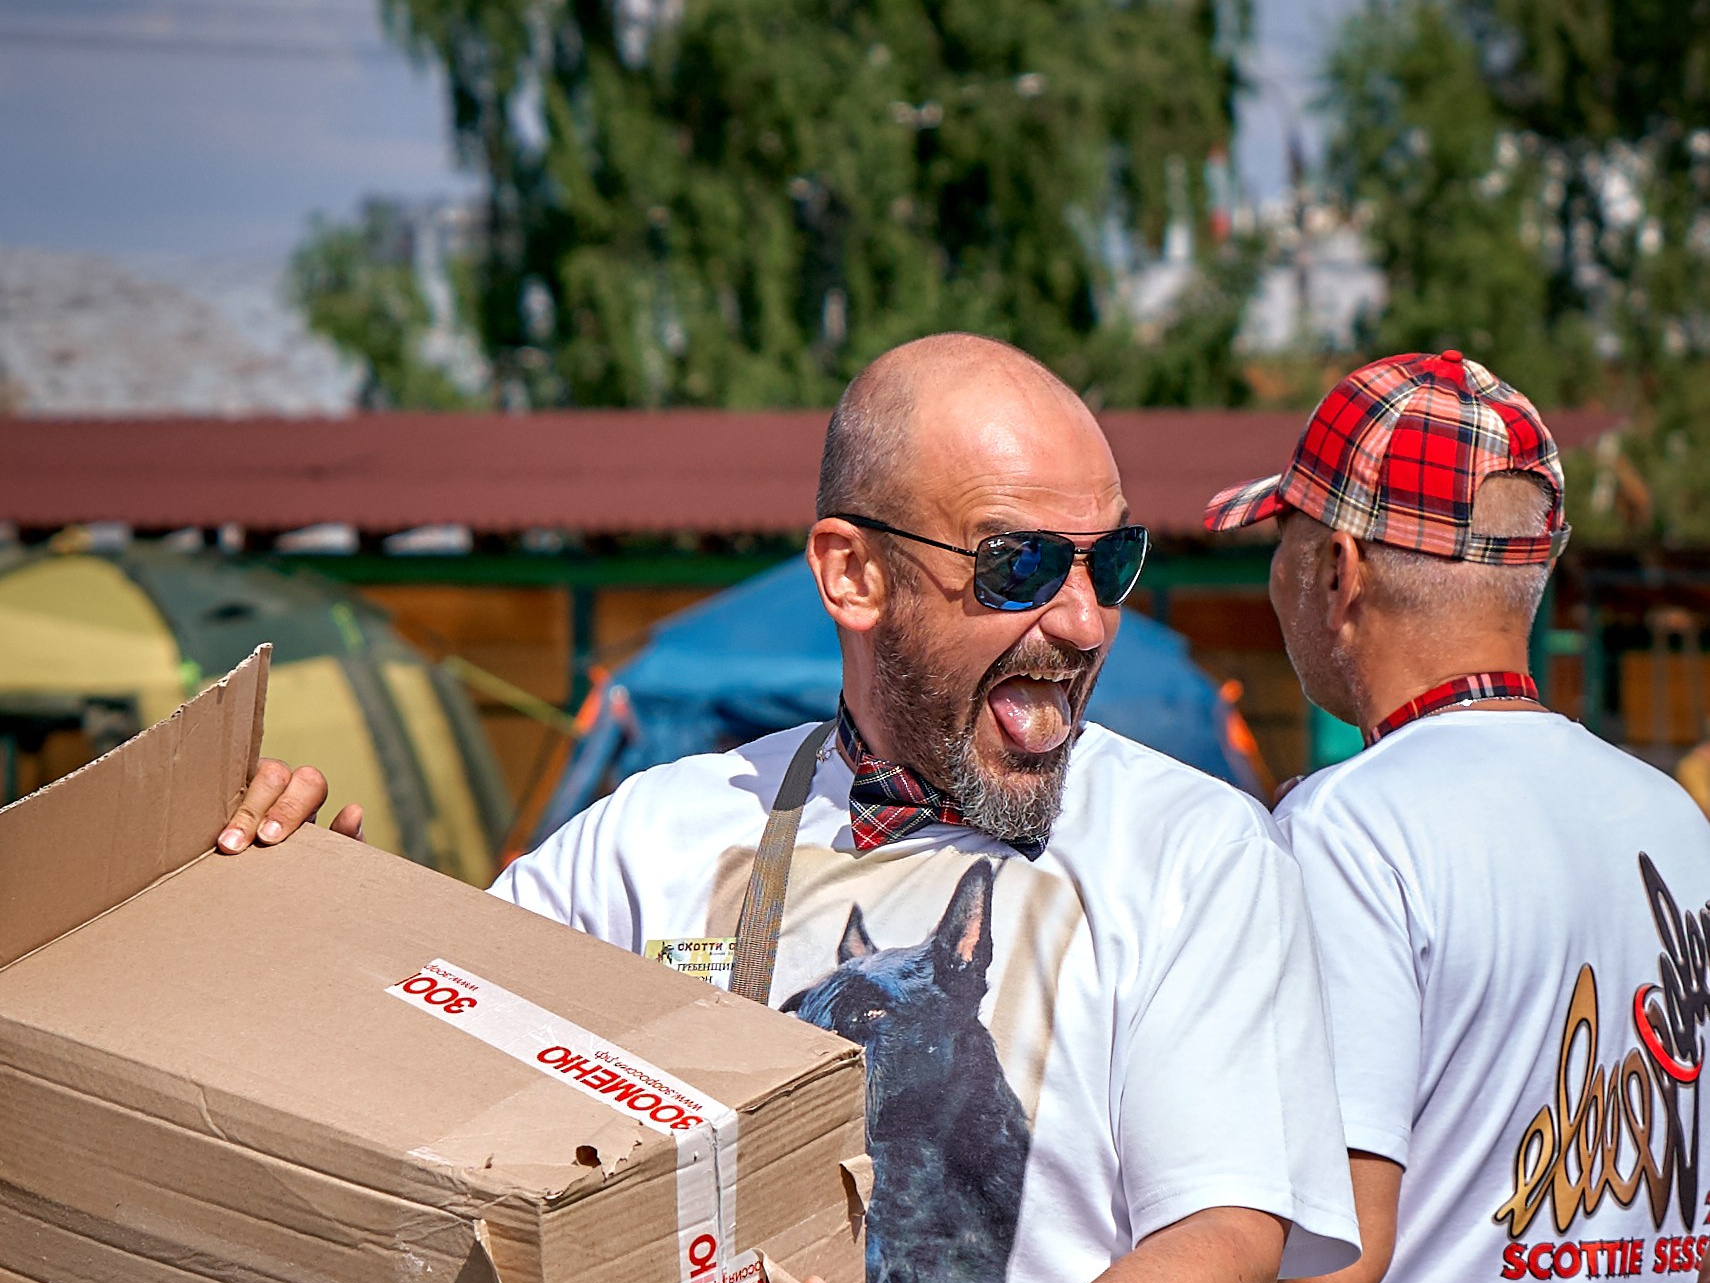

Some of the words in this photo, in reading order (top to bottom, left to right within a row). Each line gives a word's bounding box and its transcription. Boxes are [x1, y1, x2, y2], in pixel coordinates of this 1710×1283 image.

[394, 972, 478, 1014] ЗОО
[536, 1044, 705, 1131] ЗООМЕНЮ
[1500, 1237, 1645, 1280] SCOTTIE
